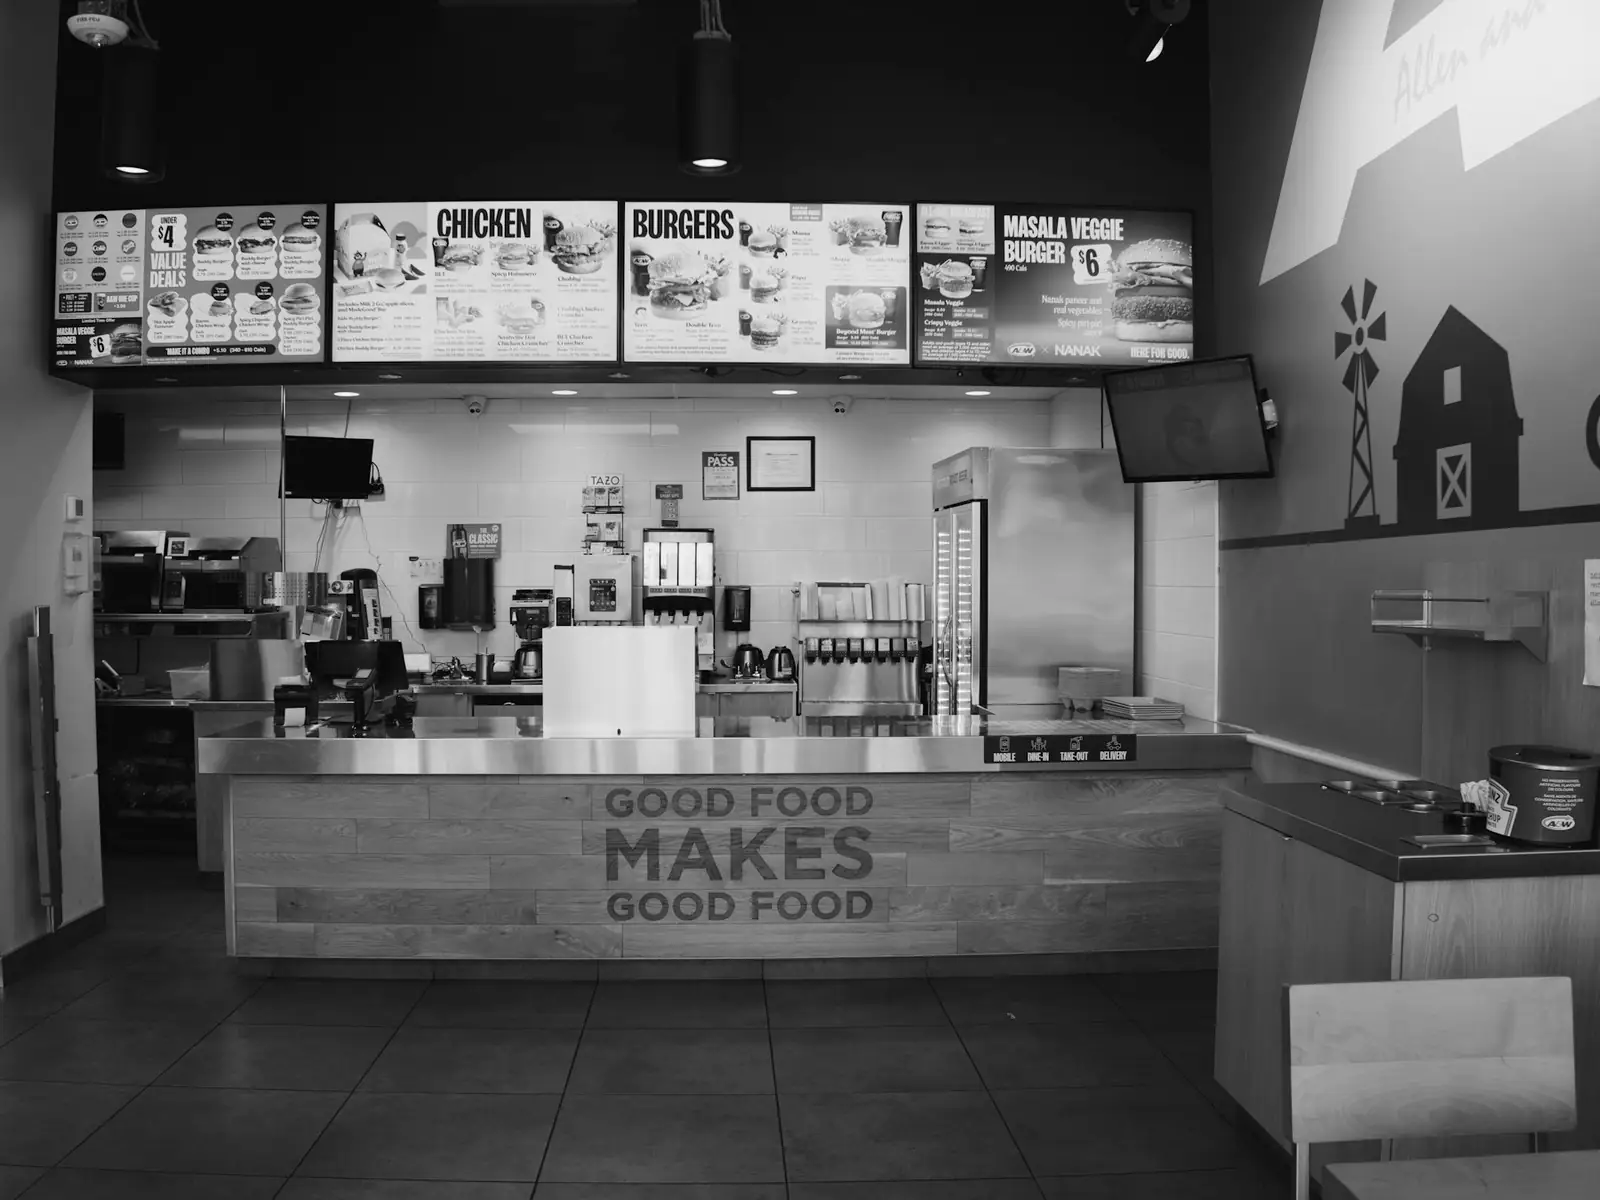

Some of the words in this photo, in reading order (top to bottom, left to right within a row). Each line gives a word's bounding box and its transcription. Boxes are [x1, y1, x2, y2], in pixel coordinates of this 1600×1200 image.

[1394, 33, 1468, 123] Allen
[160, 216, 177, 224] UNDER
[437, 208, 532, 239] CHICKEN
[633, 209, 734, 240] BURGERS
[1004, 215, 1068, 239] MASALA
[1070, 217, 1124, 241] VEGGIE
[158, 225, 174, 248] $4
[1004, 240, 1065, 264] BURGER
[150, 252, 187, 270] VALUE
[1079, 248, 1099, 276] $6
[150, 270, 186, 288] DEALS
[1042, 295, 1064, 304] Nanak
[1058, 319, 1076, 328] Spicy
[56, 327, 77, 335] MASALA
[78, 326, 96, 335] VEGGIE
[56, 336, 77, 344] BURGER
[93, 337, 104, 353] $6
[1054, 344, 1102, 357] NANAK
[1130, 347, 1150, 358] HERE
[1151, 347, 1166, 359] FOR
[1168, 348, 1190, 359] GOOD.
[707, 456, 734, 467] PASS
[591, 476, 620, 485] TAZO
[469, 534, 498, 544] CLASSIC
[993, 753, 1016, 762] MOBILE
[1027, 752, 1049, 762] DINE-IN
[1060, 752, 1088, 761] TAKE-OUT
[1100, 751, 1127, 760] DELIVERY
[605, 788, 734, 818] GOOD
[751, 786, 873, 817] FOOD
[606, 826, 873, 881] MAKES
[606, 892, 735, 921] GOOD
[751, 890, 873, 920] FOOD
